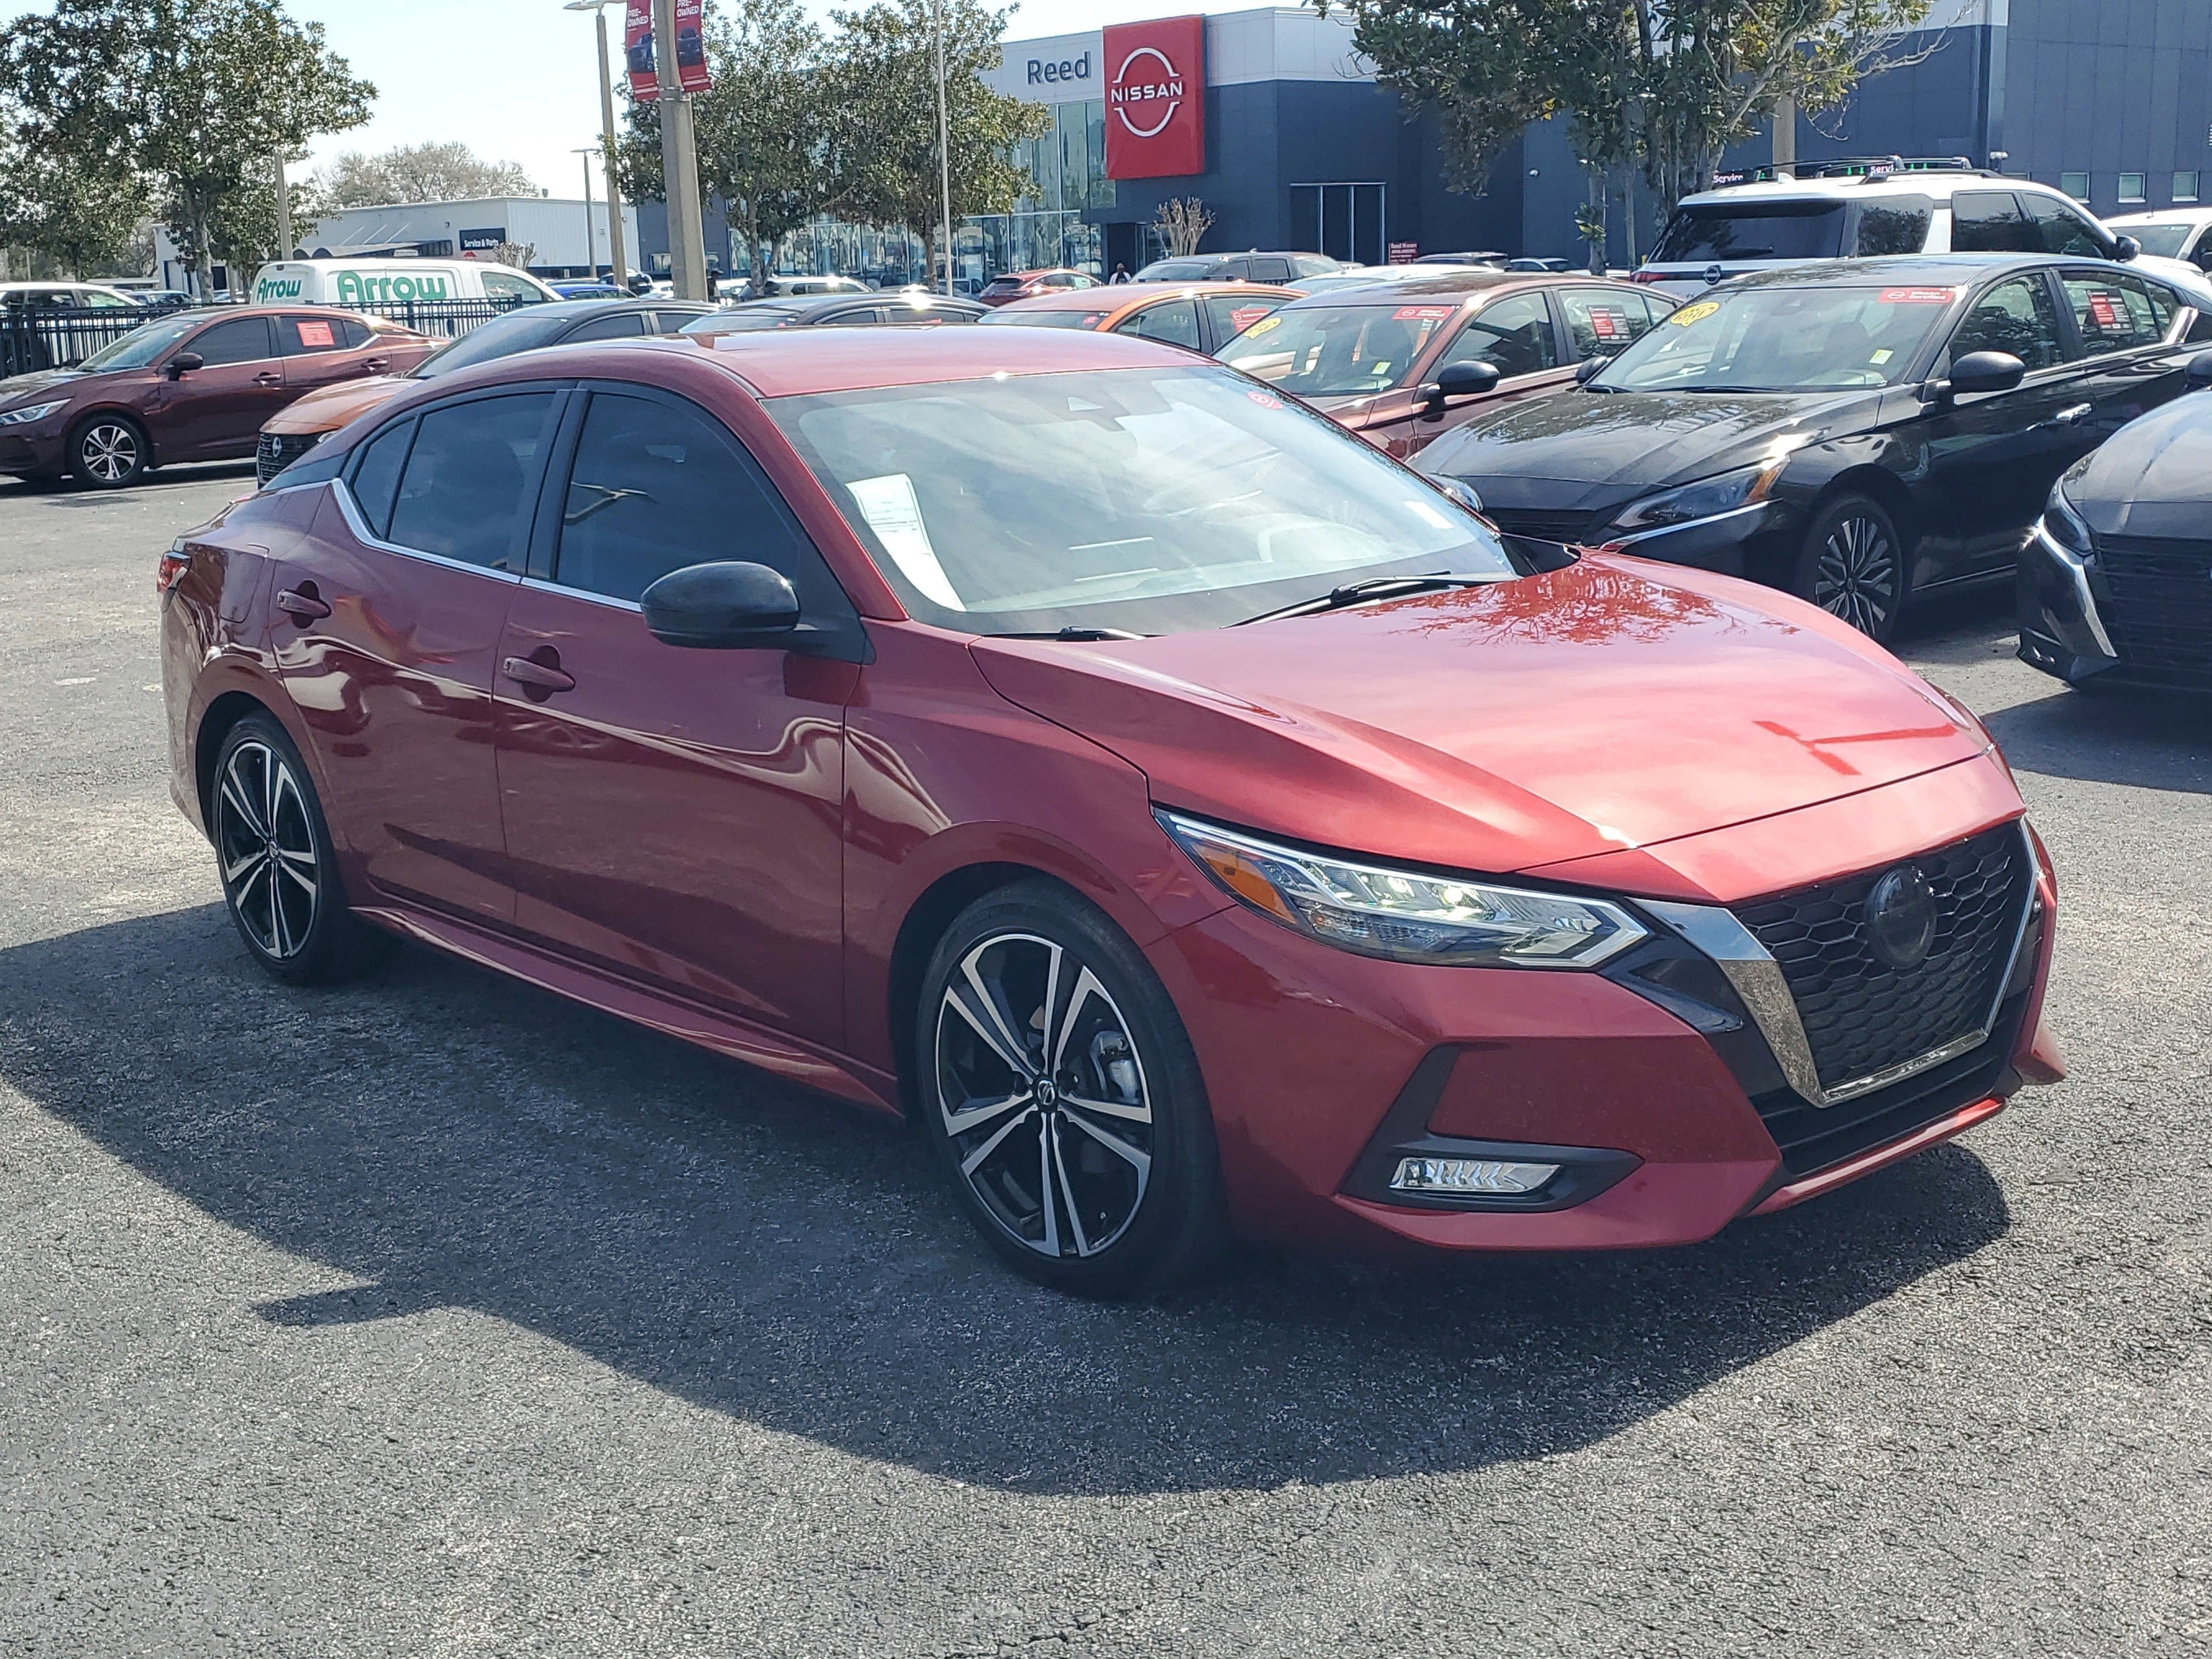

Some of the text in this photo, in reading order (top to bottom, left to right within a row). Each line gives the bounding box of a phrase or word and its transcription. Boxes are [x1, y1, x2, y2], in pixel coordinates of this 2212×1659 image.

[676, 5, 699, 17] OWNED
[627, 15, 648, 27] OWNED
[1027, 51, 1090, 84] Reed
[1111, 81, 1182, 103] NISSAN
[1871, 164, 1894, 173] Servi
[1713, 173, 1743, 183] Service
[257, 278, 301, 304] Arrow
[337, 270, 447, 302] Arrow
